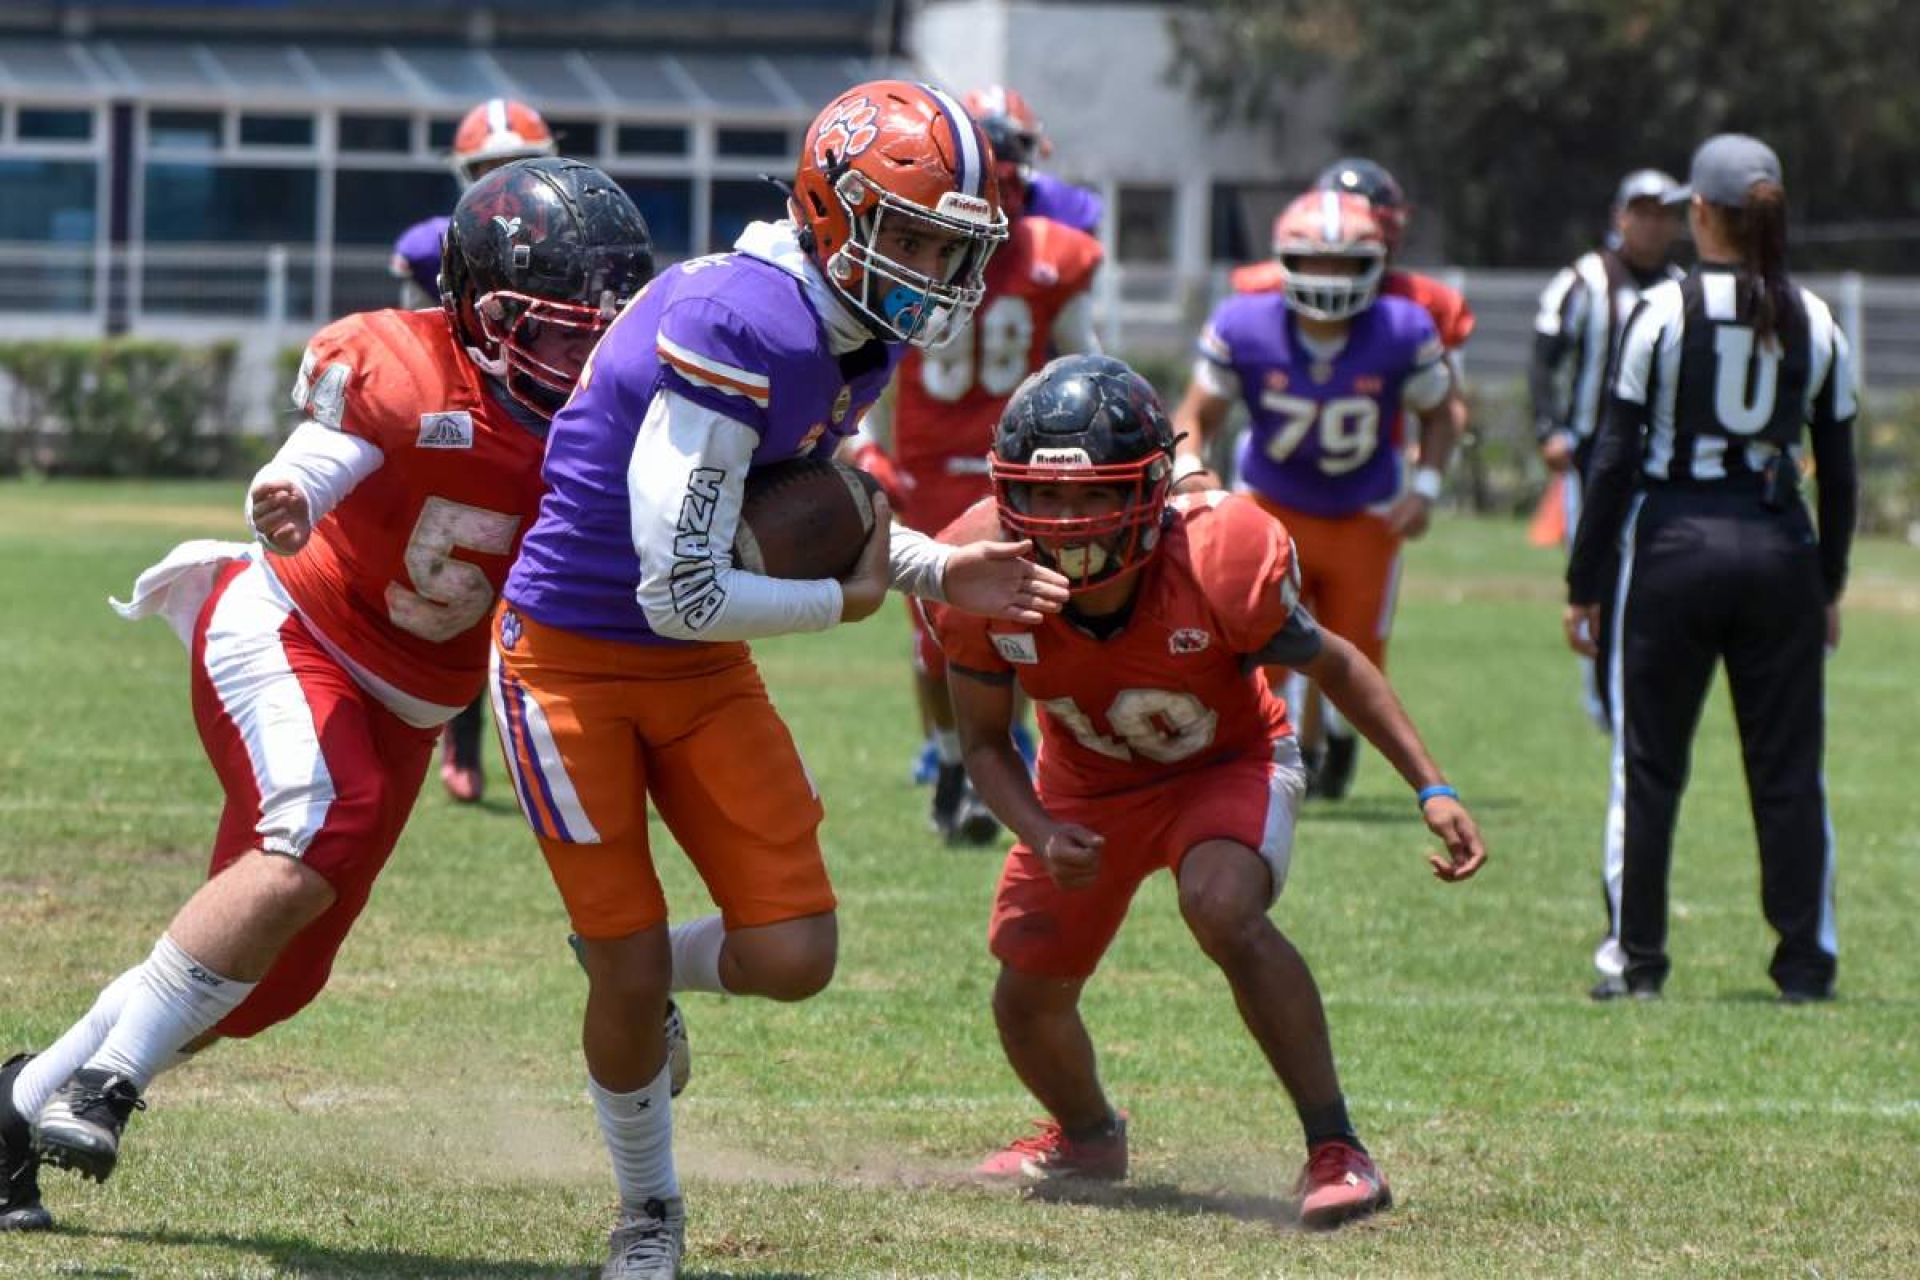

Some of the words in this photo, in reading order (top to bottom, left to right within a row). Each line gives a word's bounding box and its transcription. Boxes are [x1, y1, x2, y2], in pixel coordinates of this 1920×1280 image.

[1714, 326, 1784, 435] U
[1036, 453, 1083, 465] Riddell
[1261, 392, 1379, 475] 79
[1045, 688, 1219, 765] 10
